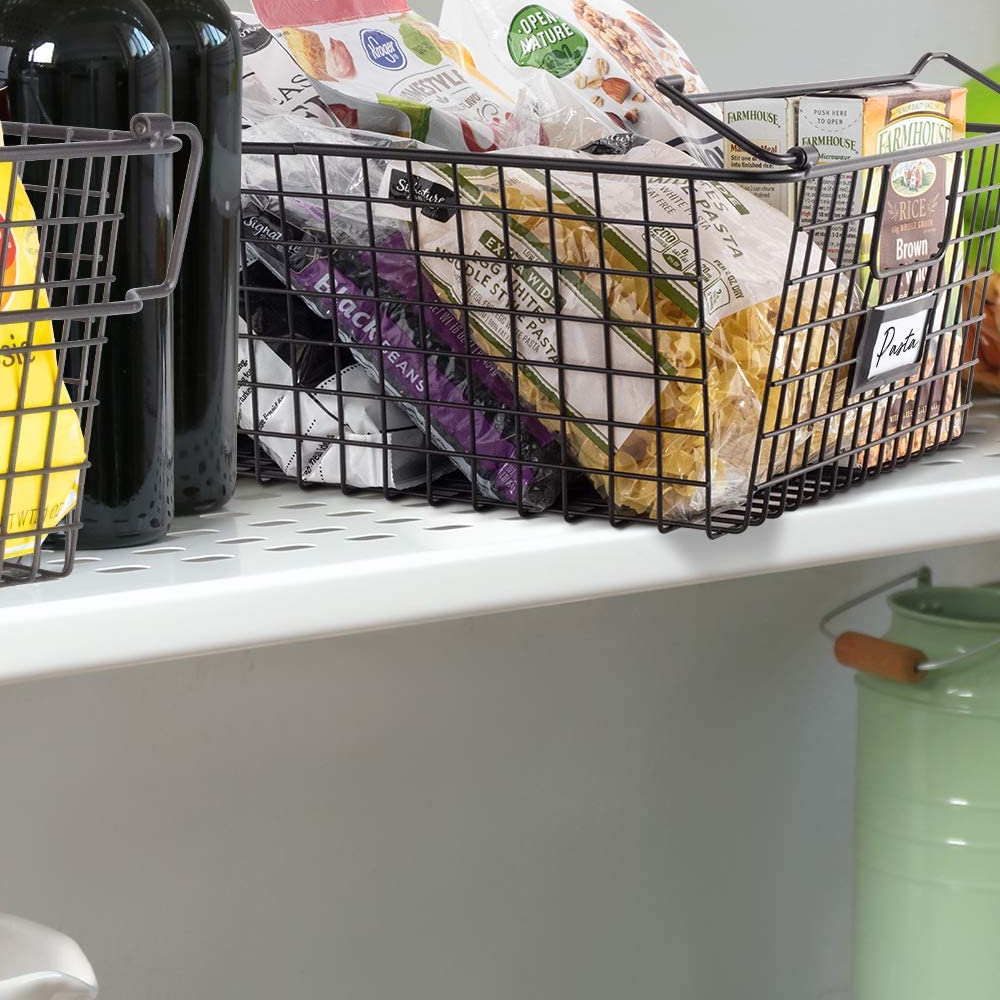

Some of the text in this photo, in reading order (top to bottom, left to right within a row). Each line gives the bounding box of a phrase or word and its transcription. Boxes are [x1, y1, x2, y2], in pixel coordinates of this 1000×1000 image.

[520, 10, 558, 35] OPEN
[367, 36, 397, 63] Kroger
[520, 22, 575, 56] NATURE
[727, 110, 779, 126] FARMHOUSE
[817, 117, 844, 126] TO OPEN
[802, 136, 857, 152] FARMHOUSE
[879, 119, 951, 154] FARMHOUSE
[742, 161, 762, 169] finished
[395, 178, 446, 204] Siature
[660, 185, 688, 209] WHITE
[656, 198, 677, 215] FREE
[899, 198, 926, 221] RICE
[696, 199, 744, 259] PASTA
[485, 236, 525, 276] EXA
[896, 238, 928, 261] Brown
[472, 250, 501, 276] EGG
[732, 284, 745, 300] DRY
[490, 281, 523, 323] STLE
[524, 320, 560, 364] PASTA
[520, 332, 542, 354] PASTA
[876, 326, 919, 368] Pasta
